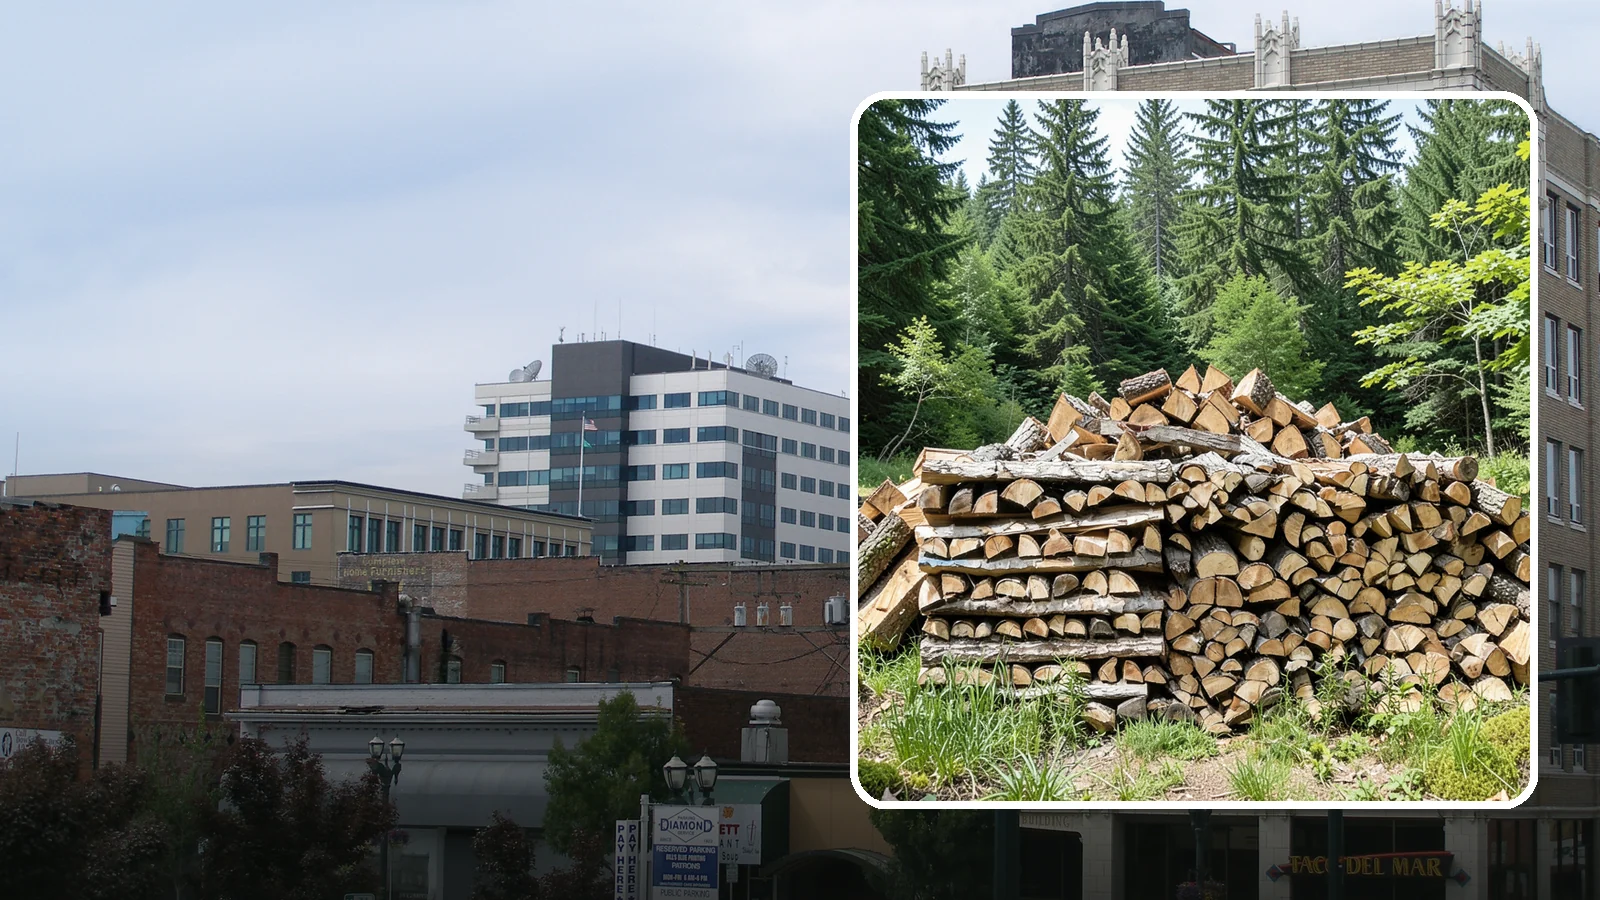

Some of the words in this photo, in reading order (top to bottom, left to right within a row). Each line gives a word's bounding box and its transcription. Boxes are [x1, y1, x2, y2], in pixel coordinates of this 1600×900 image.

[343, 567, 368, 577] Home
[371, 566, 426, 577] Furnishers
[660, 818, 713, 832] DIAMOND
[1022, 815, 1070, 828] BUILDING
[617, 825, 625, 852] PAY
[628, 825, 637, 852] PAY
[656, 845, 688, 853] RESERVED
[689, 846, 716, 854] PARKING
[722, 851, 739, 862] Soup
[671, 862, 701, 870] PATRONS
[1288, 856, 1329, 875] TAC
[1346, 857, 1385, 875] DEL
[1392, 857, 1443, 877] MAR
[616, 856, 625, 893] HERE
[627, 856, 637, 893] HERE
[661, 889, 682, 897] PUBLIC
[684, 890, 711, 899] PARKING
